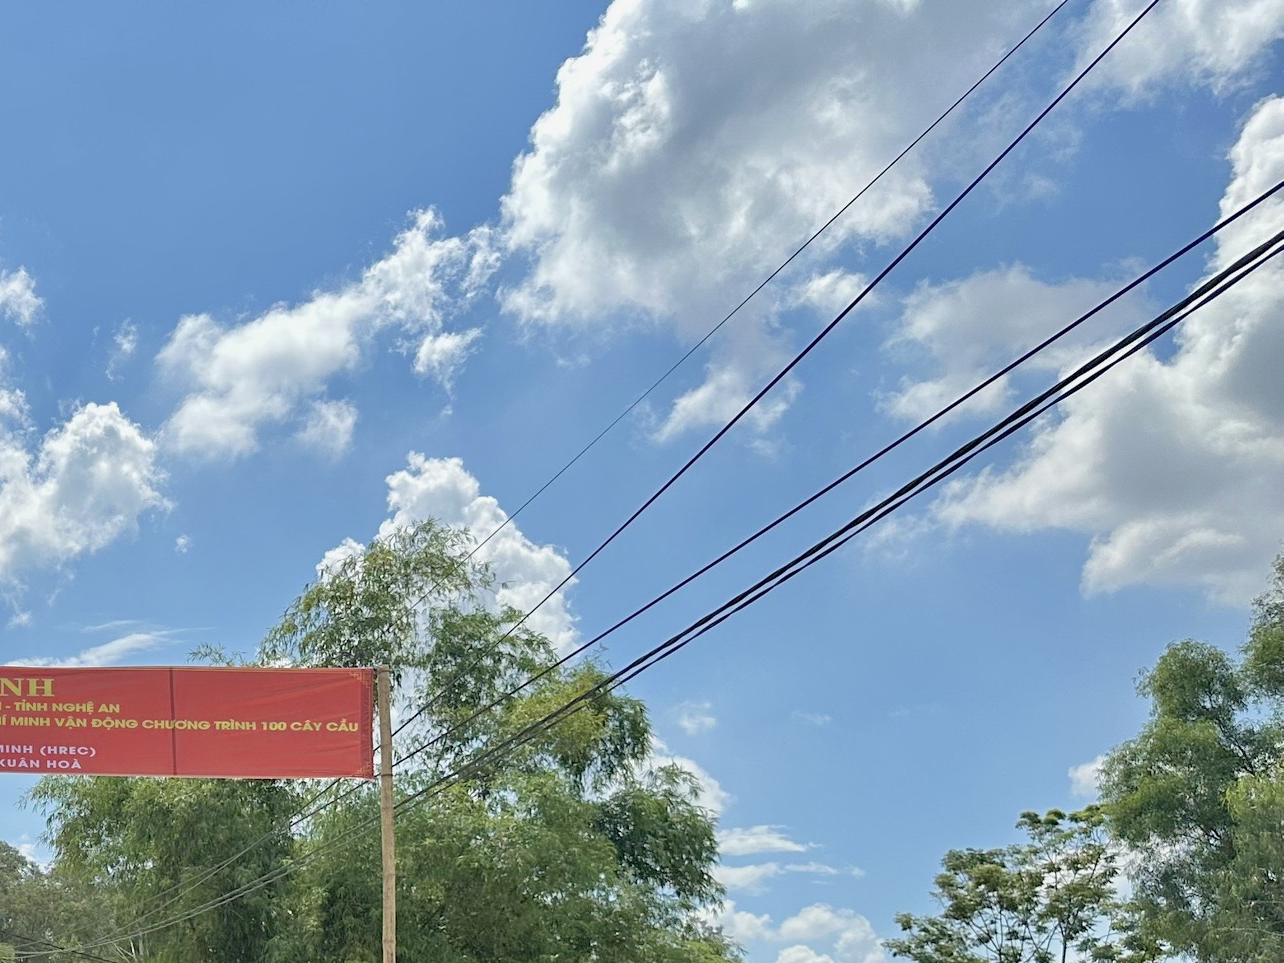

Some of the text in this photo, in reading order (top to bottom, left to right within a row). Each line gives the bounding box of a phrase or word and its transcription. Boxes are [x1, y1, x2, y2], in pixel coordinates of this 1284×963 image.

[14, 699, 48, 712] TỈNH
[51, 701, 94, 715] NGHỆ
[97, 704, 120, 713] AN
[11, 716, 51, 727] MINH
[54, 715, 87, 730] VẬN
[91, 716, 138, 731] ĐỘNG
[142, 719, 211, 731] CHƯƠNG
[213, 718, 257, 731] TRÌNH
[261, 721, 287, 731] 100
[290, 719, 322, 732] CÂY
[325, 718, 359, 732] CẦU
[39, 745, 97, 757] (HREC)
[46, 757, 82, 770] HOÀ
